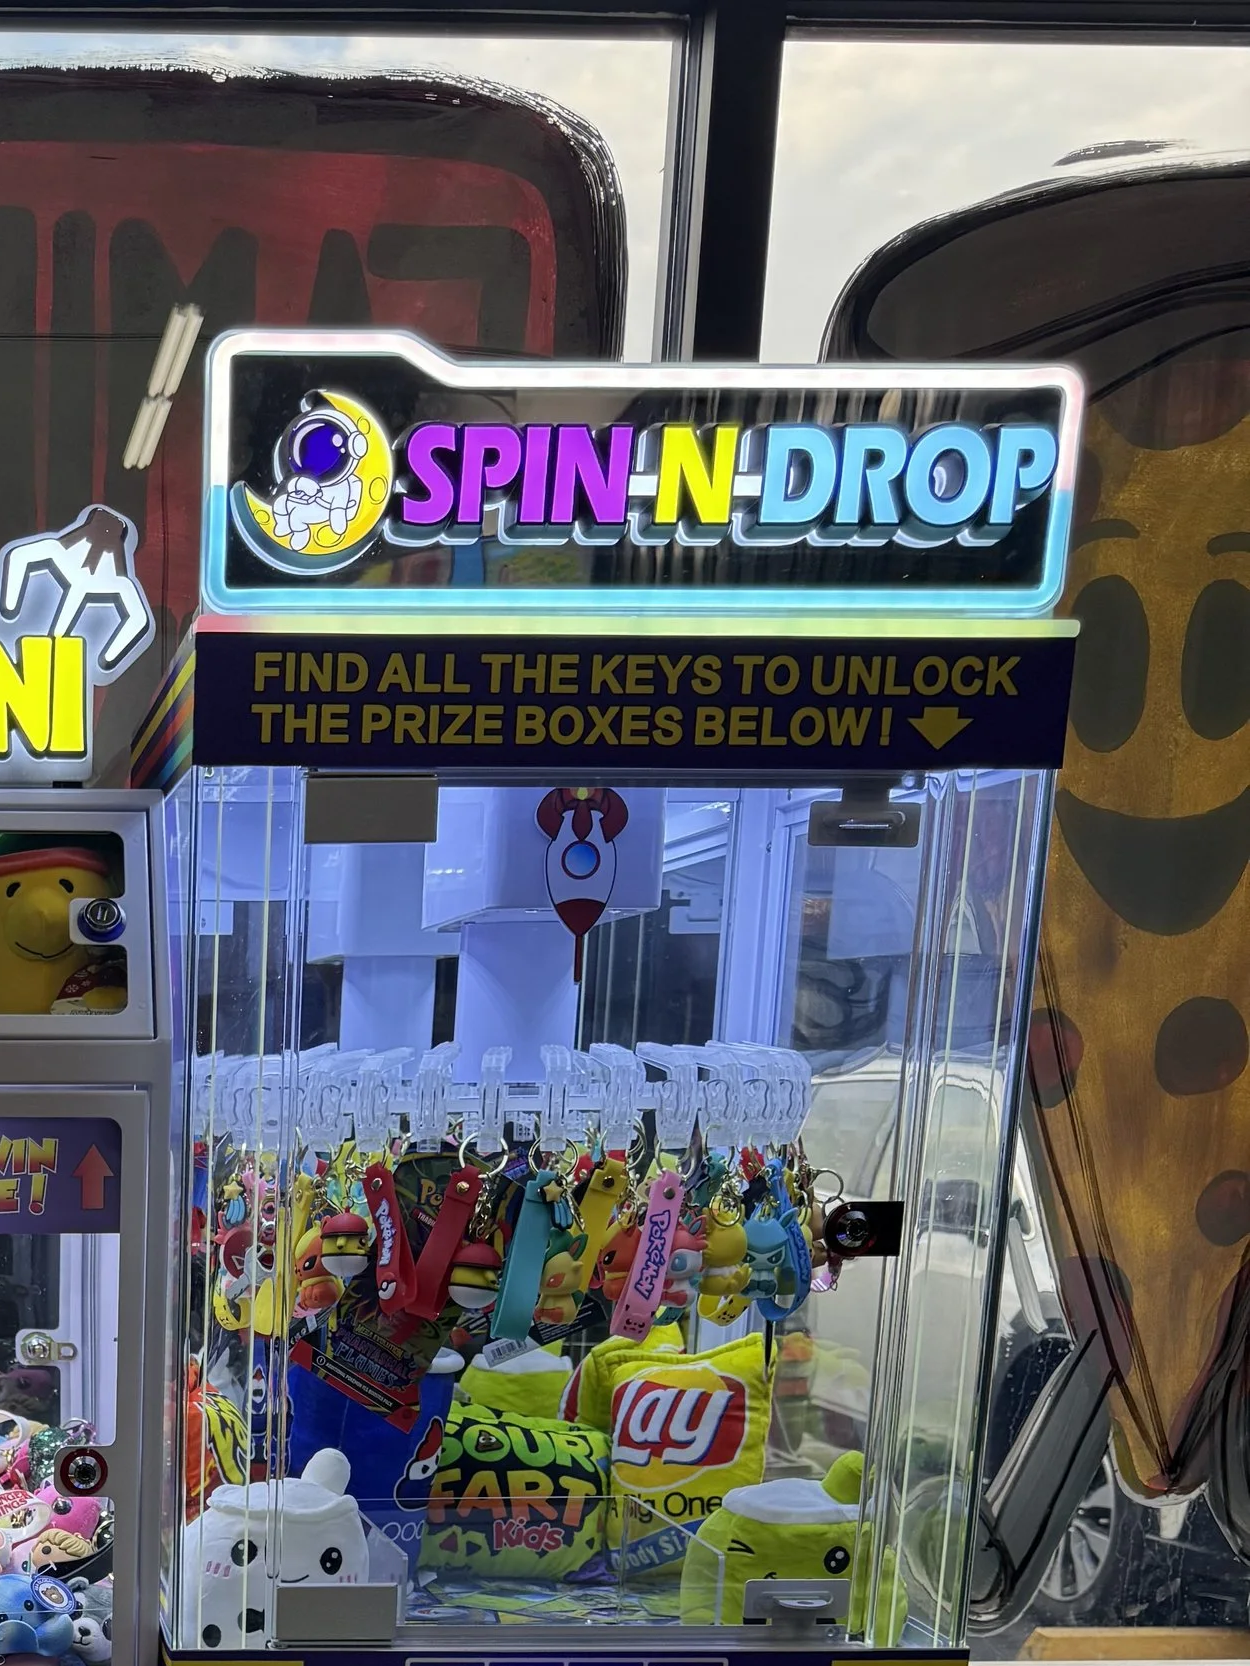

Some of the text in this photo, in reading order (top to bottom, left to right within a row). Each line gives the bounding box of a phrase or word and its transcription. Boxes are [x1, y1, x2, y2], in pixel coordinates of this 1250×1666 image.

[254, 652, 1021, 698] FIND ALL THE KEYS TO UNLOCK
[252, 703, 351, 744] THE
[362, 704, 504, 745] PRIZE
[516, 704, 686, 746] BOXES
[428, 1468, 598, 1528] FART
[664, 1491, 723, 1517] One
[493, 1516, 565, 1551] Kids
